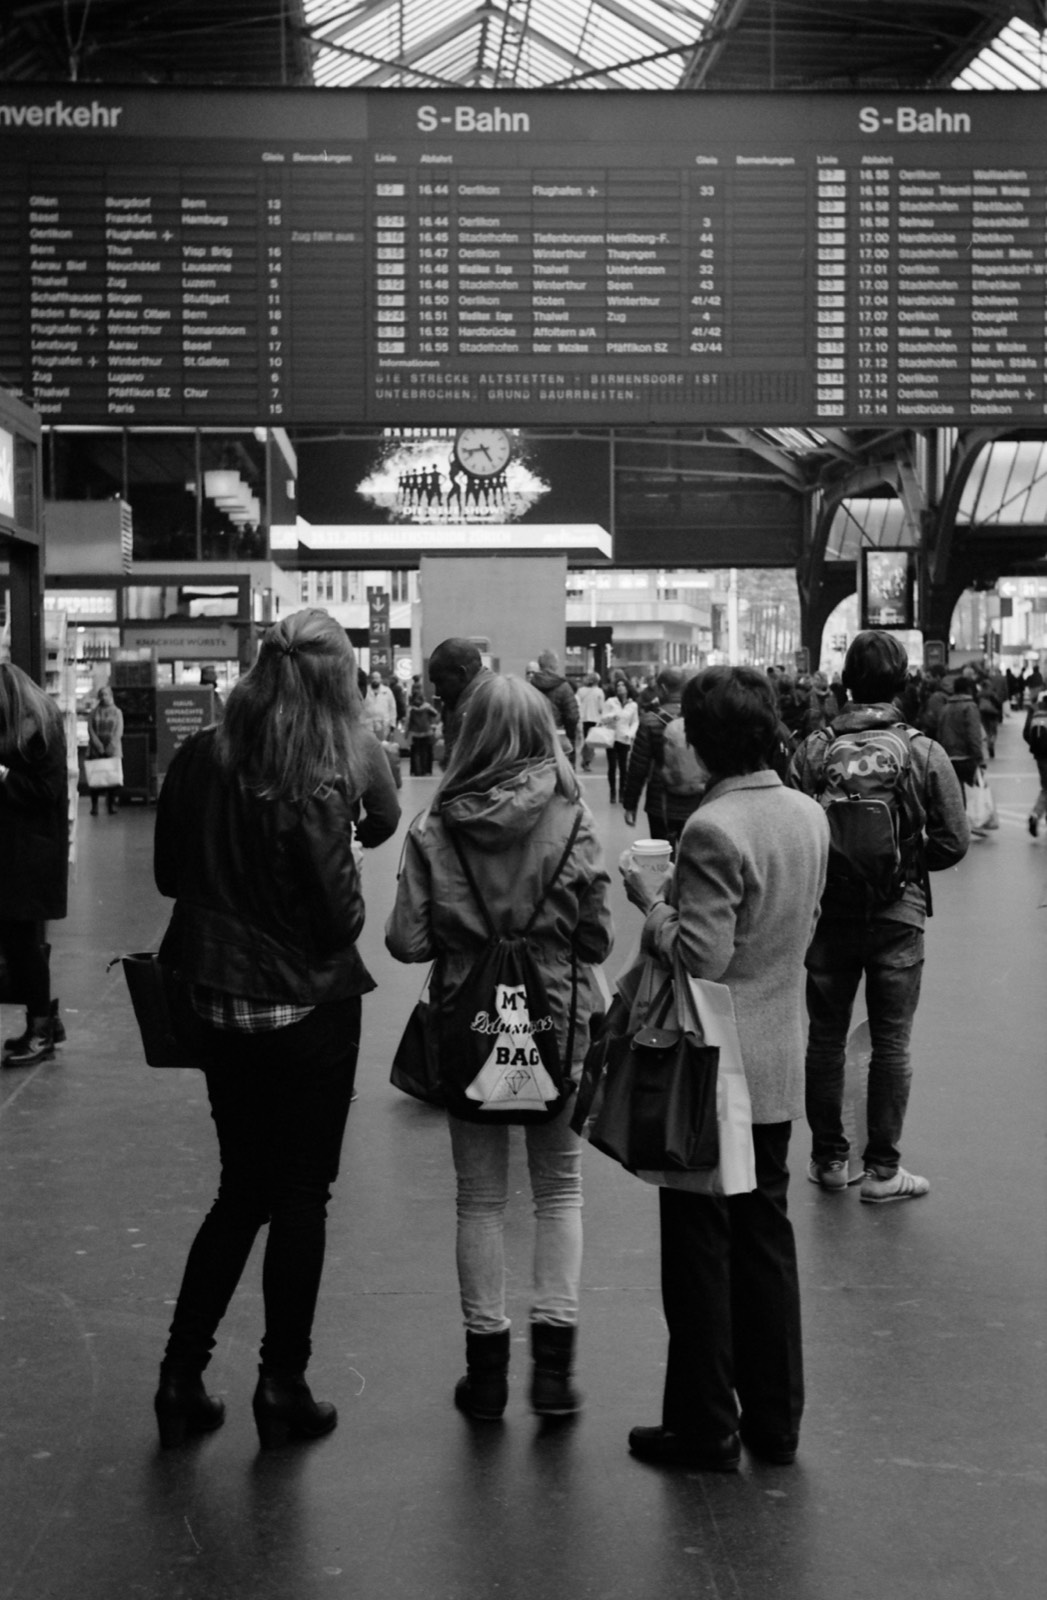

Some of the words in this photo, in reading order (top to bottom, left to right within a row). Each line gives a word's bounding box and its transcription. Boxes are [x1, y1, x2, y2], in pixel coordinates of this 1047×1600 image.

[418, 106, 529, 132] S-Bahn
[859, 107, 970, 133] S-Bahn
[379, 359, 440, 367] Informationen
[410, 374, 470, 385] STRECKE
[479, 374, 565, 386] ALTSTETTEN
[373, 622, 386, 633] 21
[495, 1047, 540, 1066] BAG
